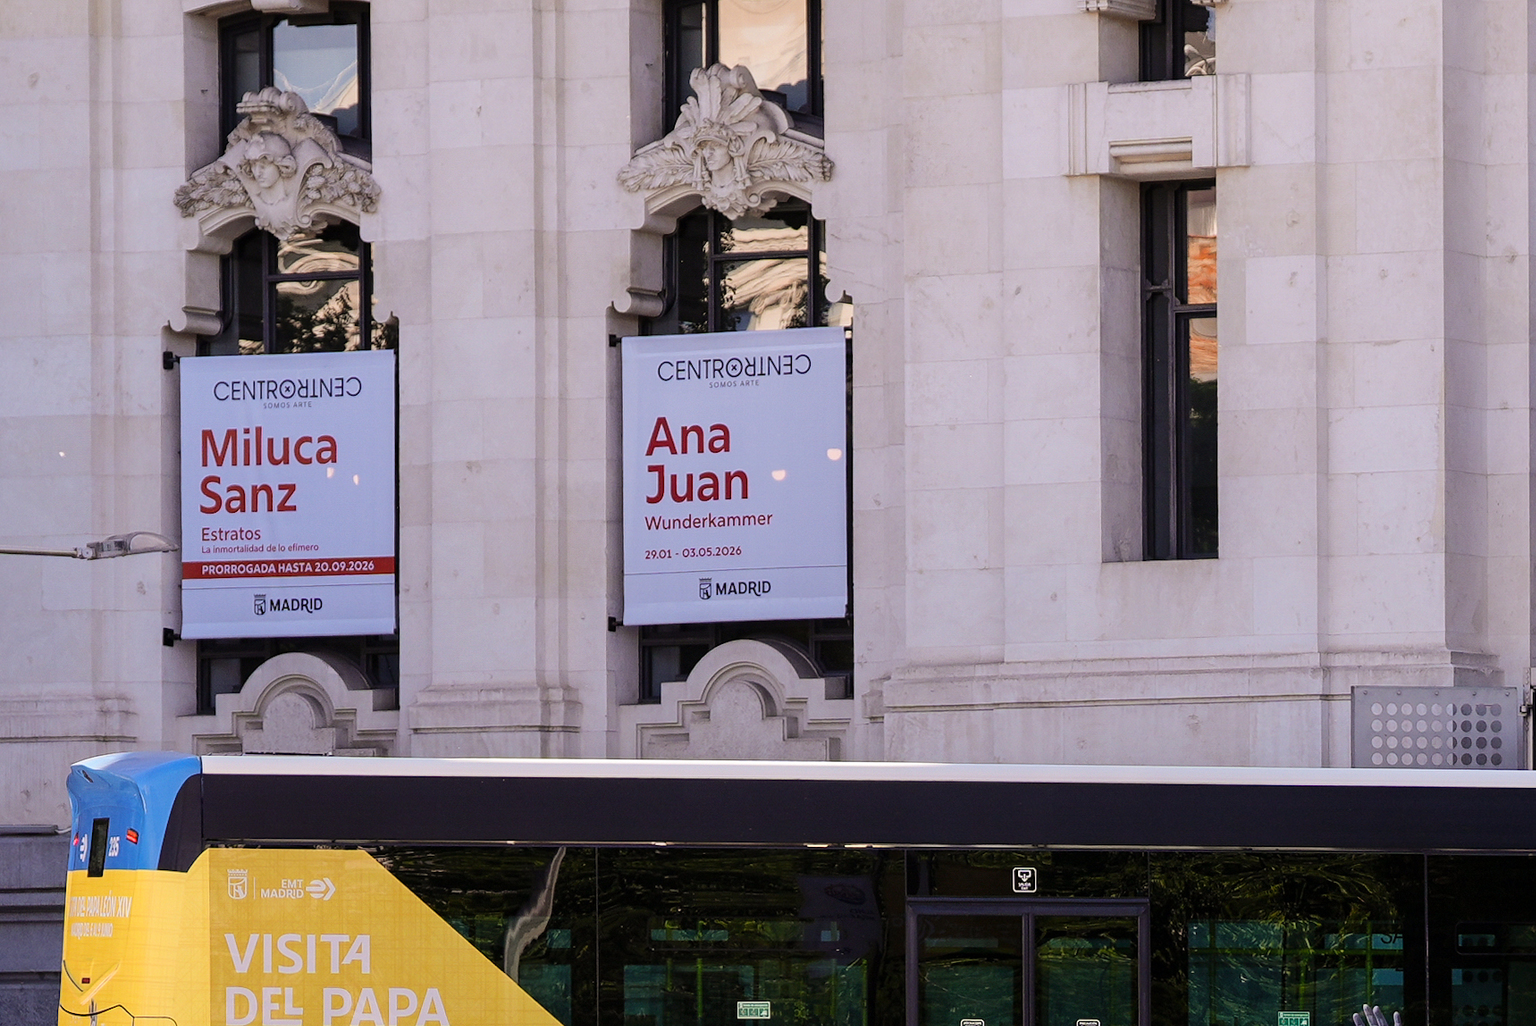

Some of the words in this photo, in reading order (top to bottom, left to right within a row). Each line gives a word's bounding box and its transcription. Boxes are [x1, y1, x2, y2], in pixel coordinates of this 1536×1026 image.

[740, 379, 759, 387] ARTE
[645, 416, 730, 456] Ana
[201, 426, 337, 467] Miluca
[645, 464, 749, 504] Juan
[200, 475, 297, 514] Sanz
[645, 513, 773, 530] Wunderkammer
[201, 527, 261, 541] Estratos
[213, 543, 264, 553] inmortalidad
[266, 543, 277, 552] de
[278, 543, 285, 552] lo
[287, 542, 319, 552] efímero
[645, 550, 672, 560] 29.01
[682, 546, 742, 558] 03.05.2026
[201, 563, 276, 575] PRORROGADA
[278, 562, 312, 573] HASTA
[314, 560, 375, 572] 20.09.2026
[715, 581, 771, 597] MADRID
[269, 597, 323, 613] MADRID
[281, 879, 304, 888] EMT
[260, 889, 304, 899] MADRID
[224, 933, 371, 974] VISITA
[225, 986, 304, 1026] DEL
[322, 987, 451, 1026] PAPA
